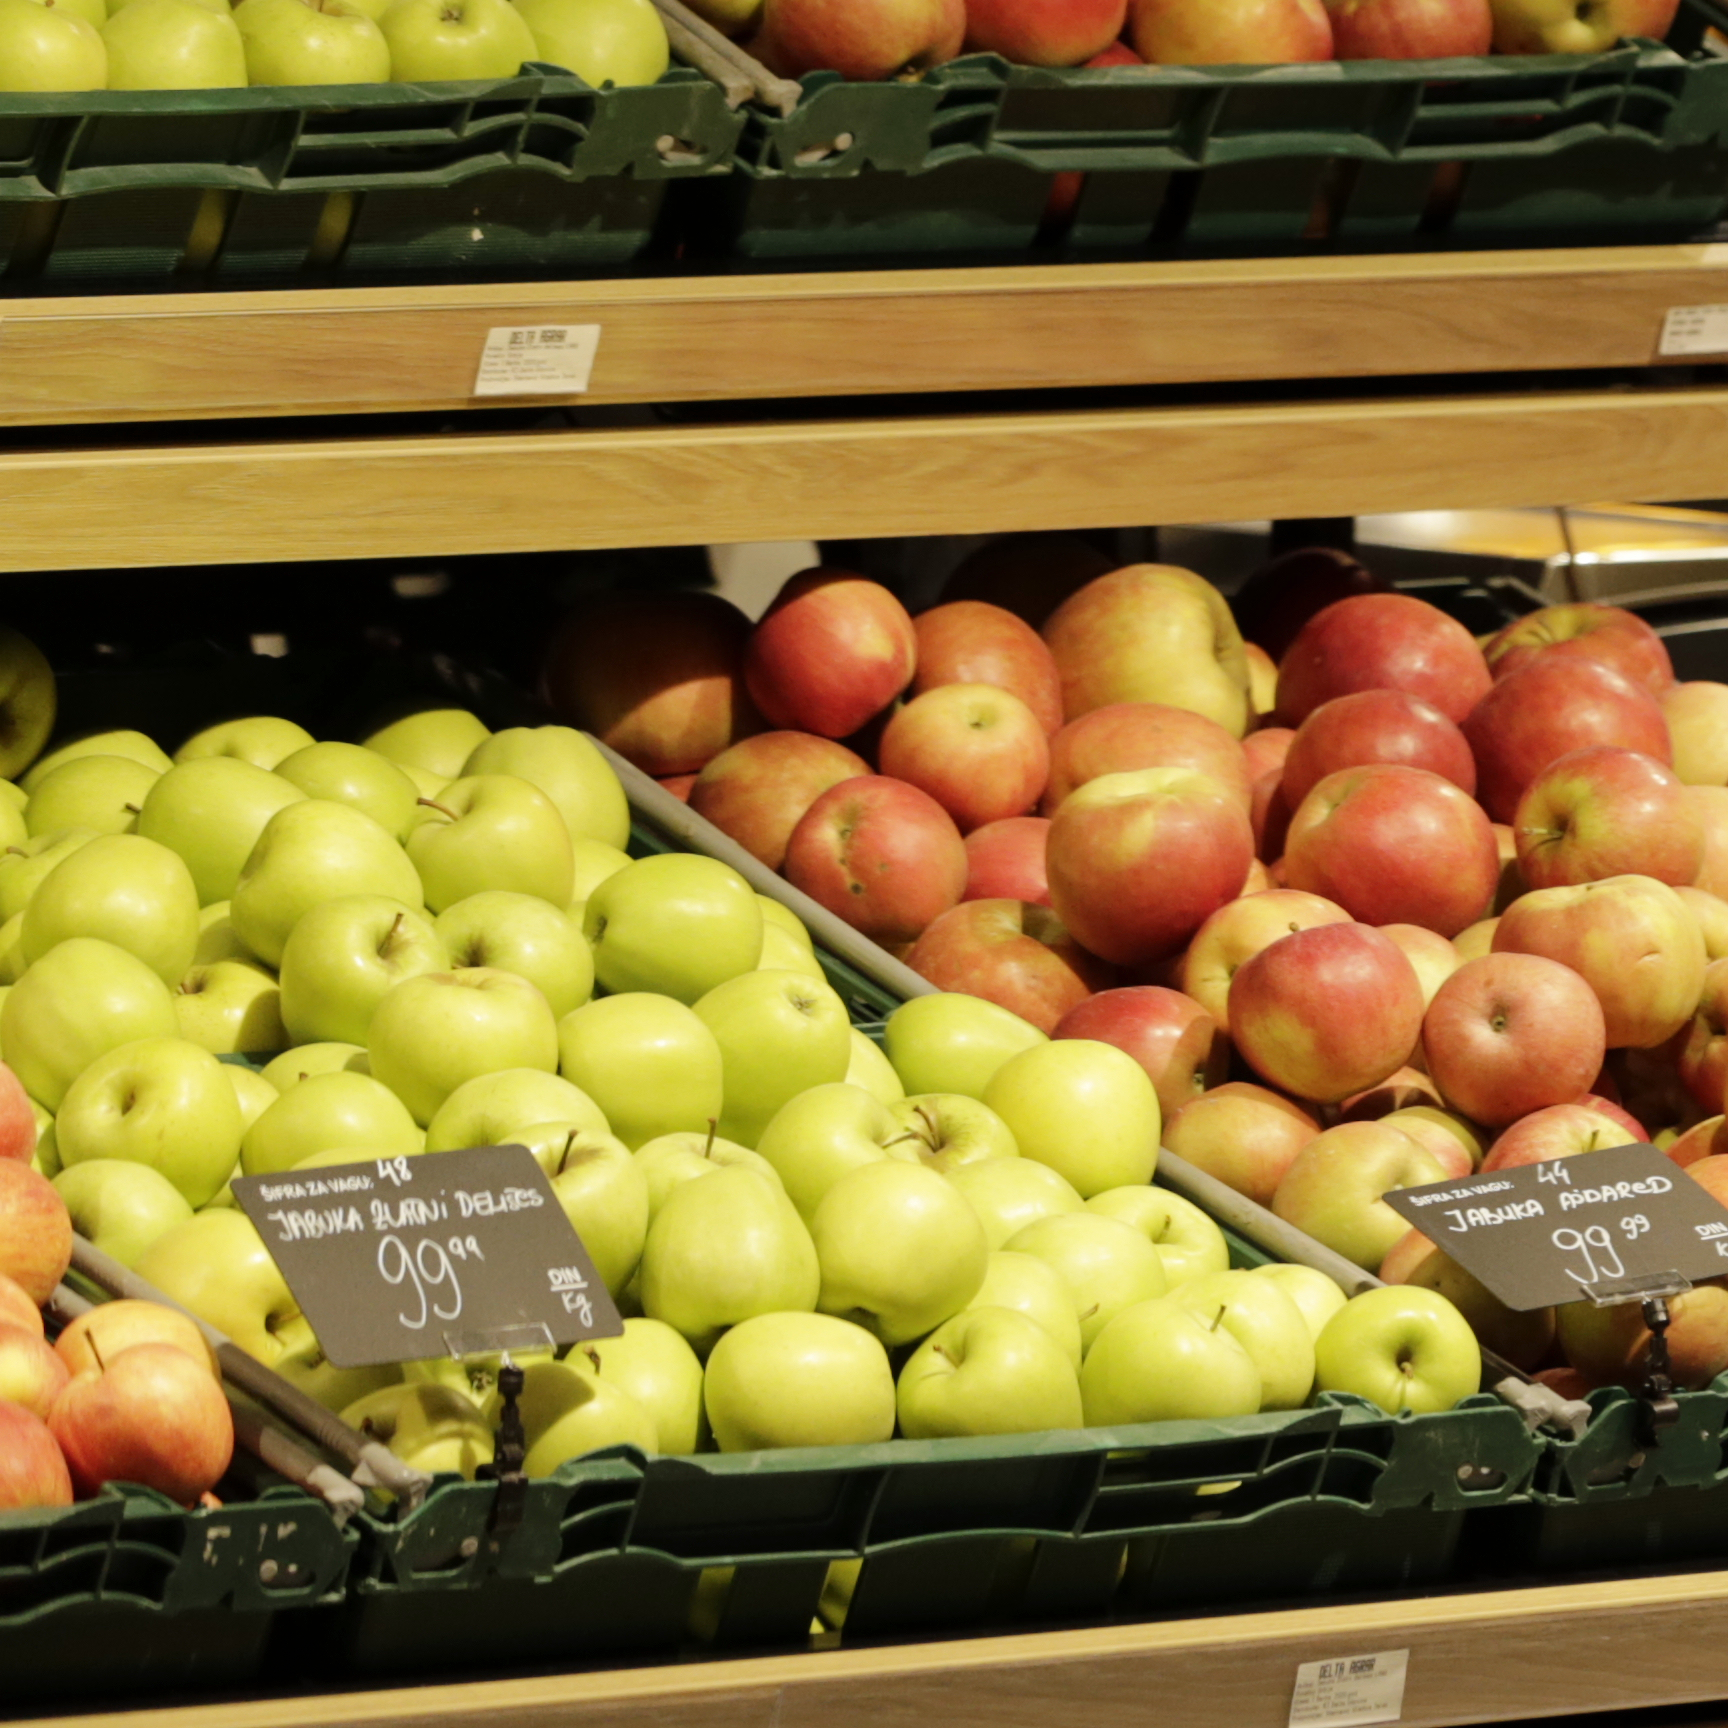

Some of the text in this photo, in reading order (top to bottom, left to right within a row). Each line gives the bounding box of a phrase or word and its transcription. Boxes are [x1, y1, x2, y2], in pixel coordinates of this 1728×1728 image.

[305, 1179, 330, 1196] ZA
[376, 1154, 413, 1187] 48
[1451, 1188, 1474, 1200] ZA
[1536, 1160, 1571, 1185] 44
[267, 1205, 365, 1242] JABUKA
[1443, 1198, 1545, 1232] JABUKA
[1695, 1221, 1728, 1237] DIN
[548, 1266, 583, 1285] DIN
